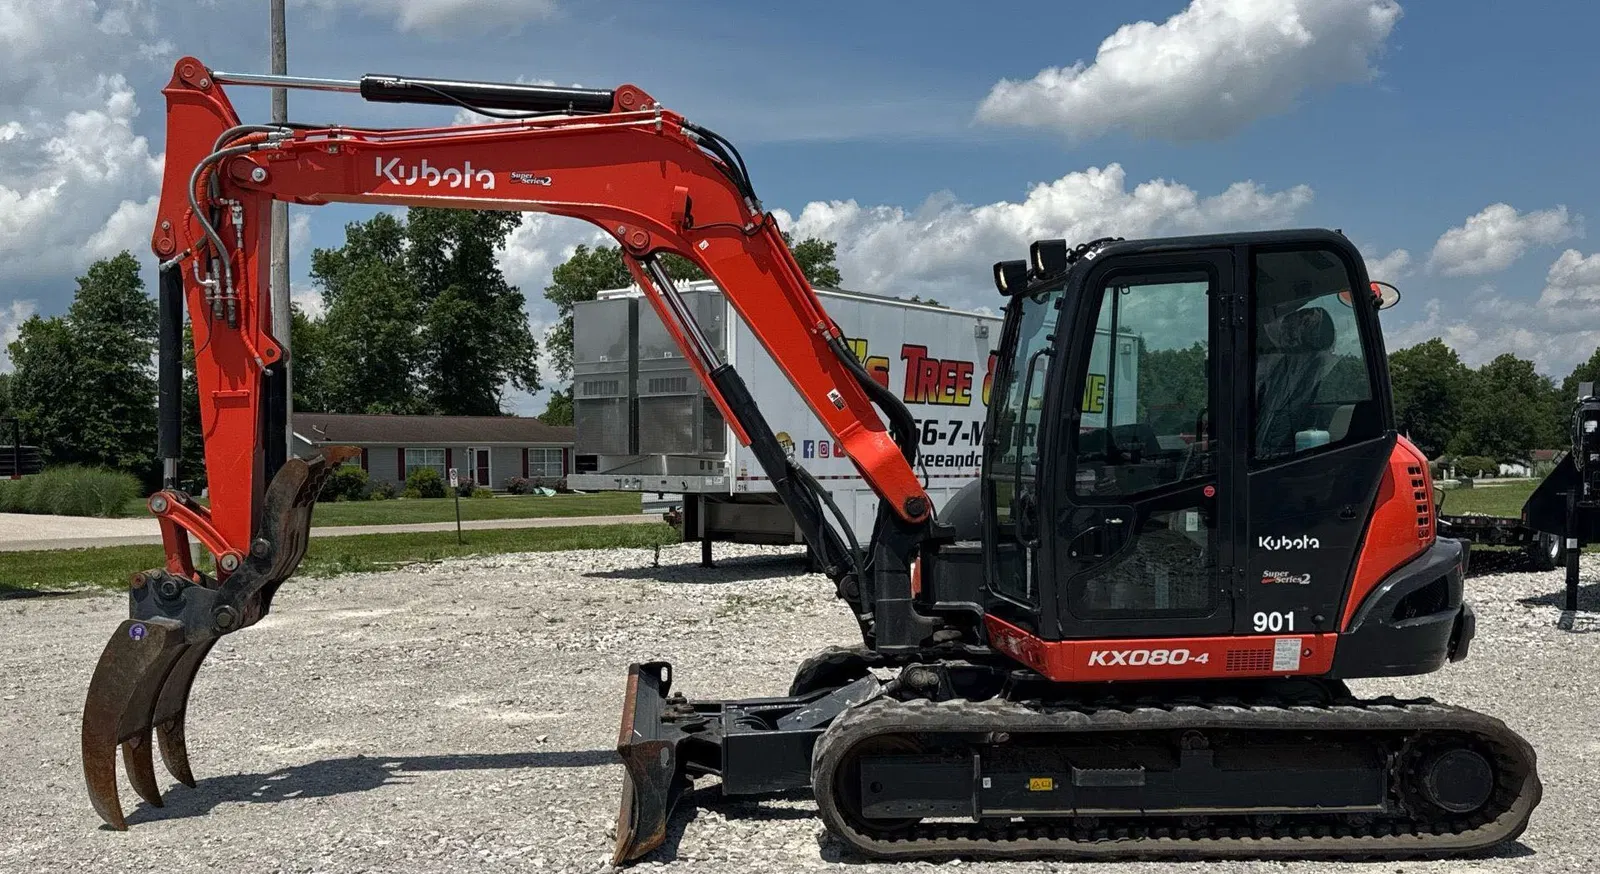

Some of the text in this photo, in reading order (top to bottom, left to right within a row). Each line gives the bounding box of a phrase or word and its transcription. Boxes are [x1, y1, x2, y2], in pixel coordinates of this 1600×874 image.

[375, 156, 495, 190] Kubota
[511, 171, 534, 180] Super
[1258, 534, 1320, 551] Kubota
[1262, 570, 1290, 579] Super
[1253, 611, 1294, 632] 901
[1088, 649, 1209, 666] KX080-4
